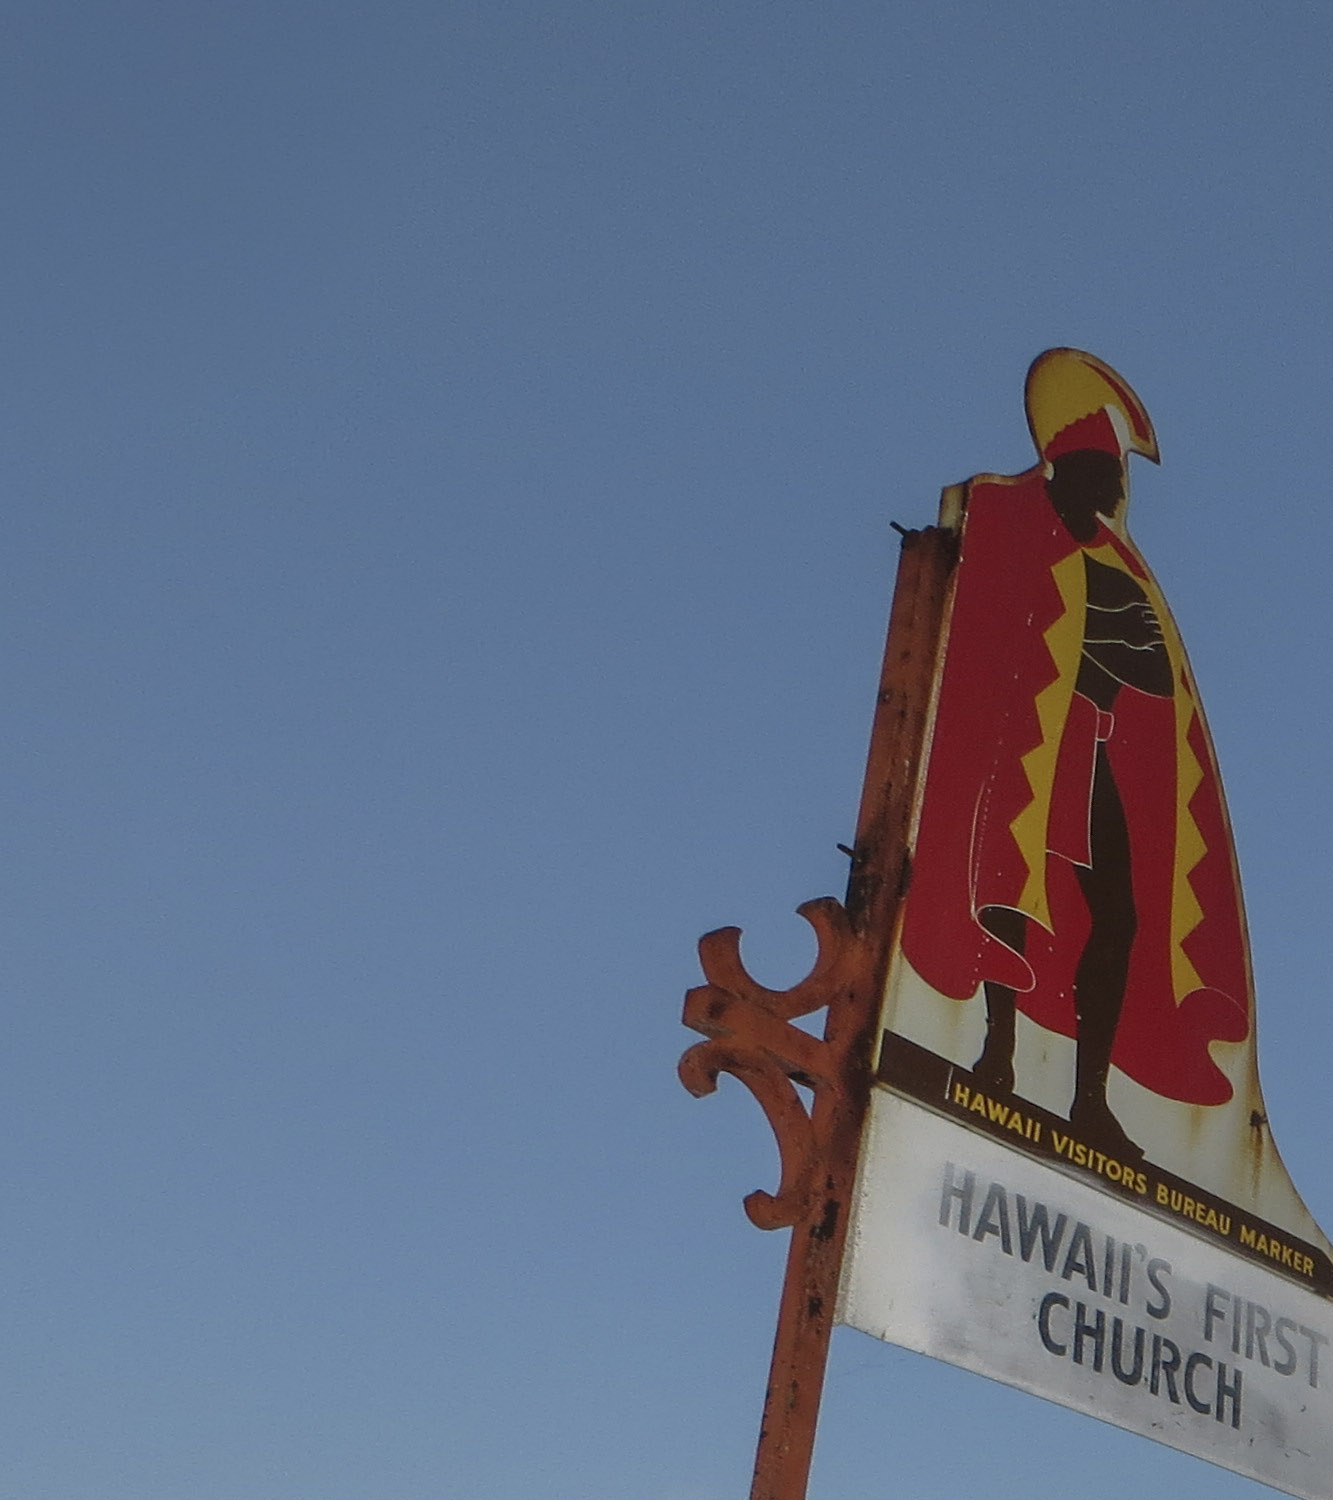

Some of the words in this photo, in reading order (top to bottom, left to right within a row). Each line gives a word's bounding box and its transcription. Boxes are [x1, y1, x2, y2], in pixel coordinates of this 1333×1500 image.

[938, 1161, 1172, 1320] HAWAII'S
[1204, 1282, 1330, 1389] FIRST
[955, 1083, 1041, 1143] HAWAII
[1052, 1130, 1148, 1195] VISITORS
[1157, 1182, 1232, 1236] BUREAU
[1240, 1225, 1315, 1277] MARKER
[1037, 1291, 1244, 1430] CHURCH
